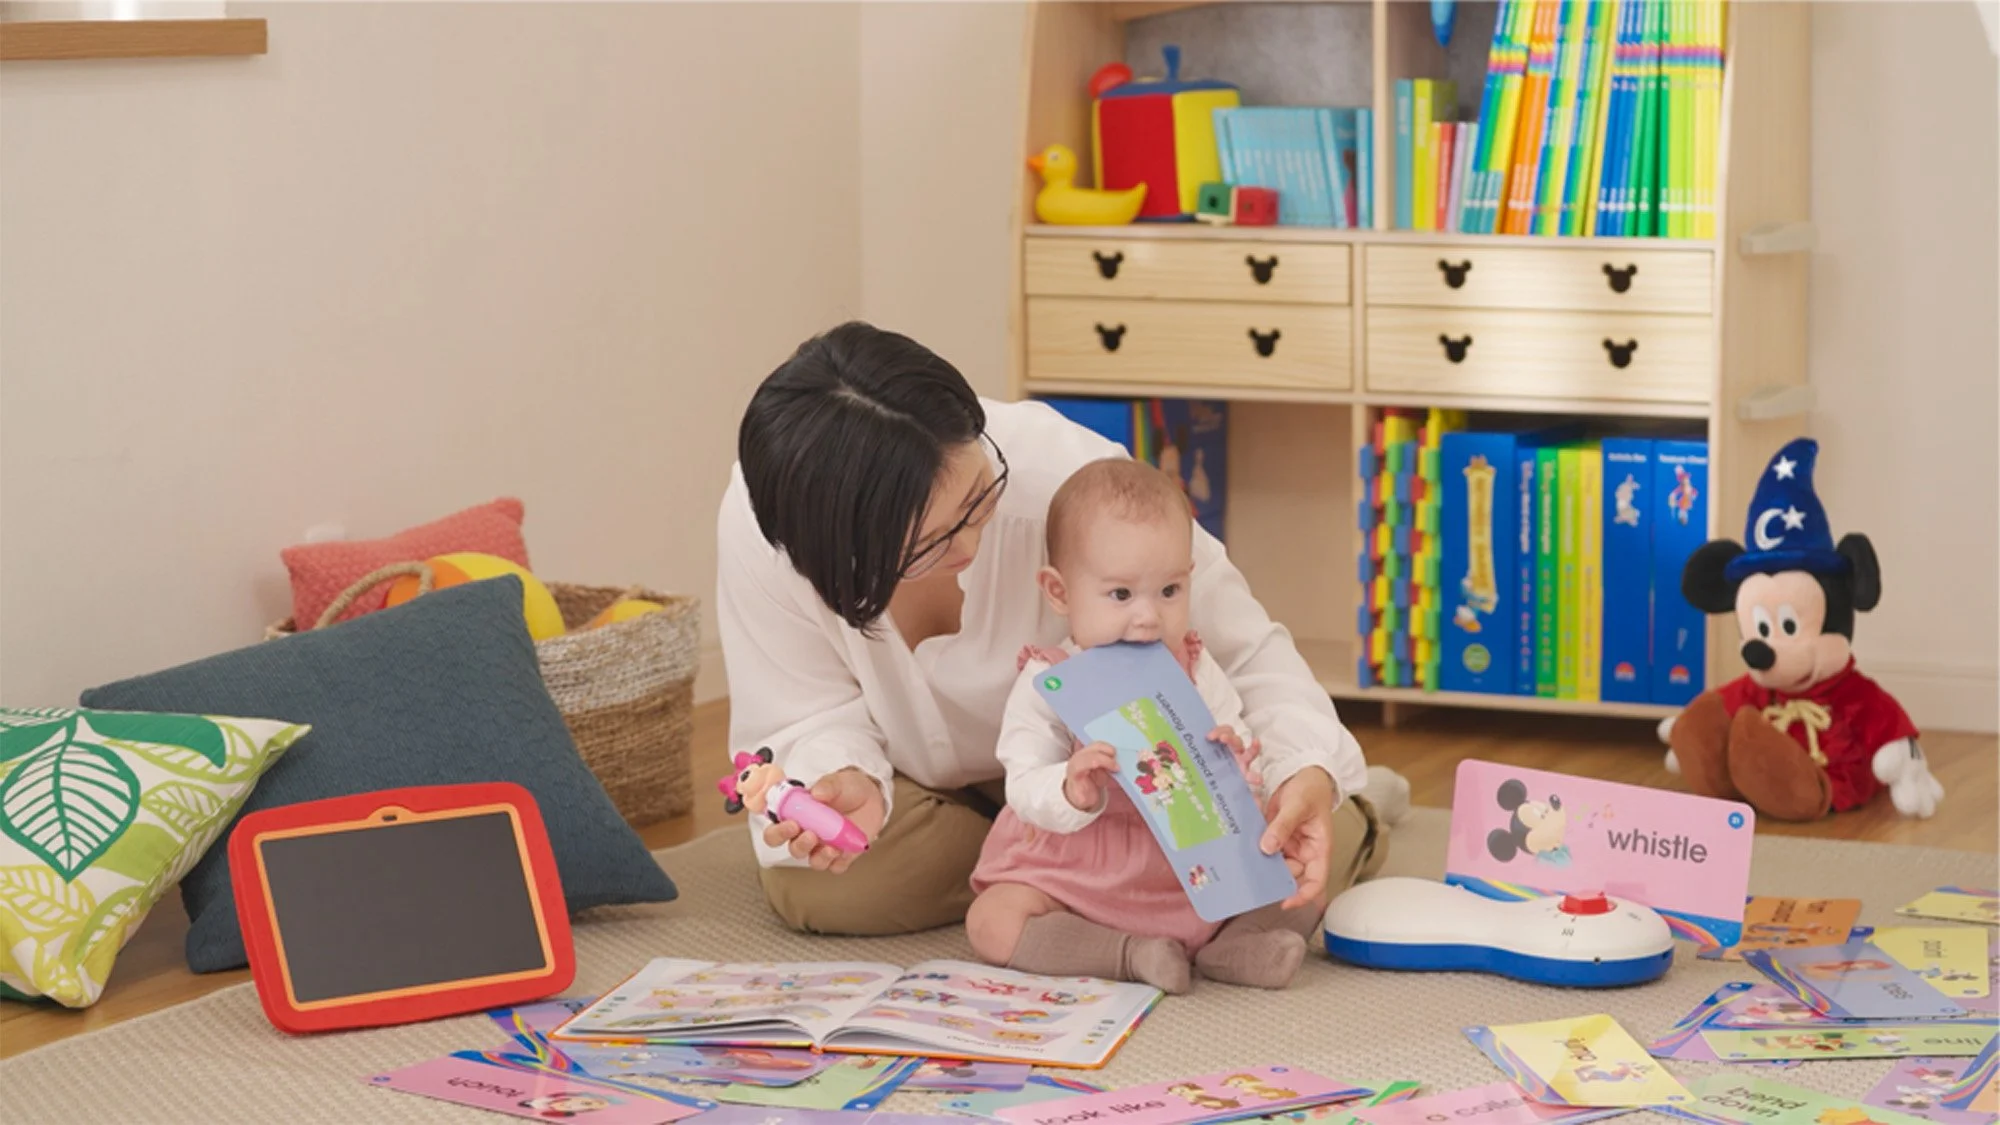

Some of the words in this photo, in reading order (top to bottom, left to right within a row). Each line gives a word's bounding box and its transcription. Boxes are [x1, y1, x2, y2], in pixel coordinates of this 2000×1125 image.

[1182, 733, 1214, 778] picking
[1217, 788, 1241, 835] Minnie
[1607, 826, 1708, 865] whistle
[1034, 1109, 1107, 1125] look
[1108, 1099, 1167, 1115] like
[1702, 1095, 1781, 1118] down
[1727, 1087, 1808, 1110] bend
